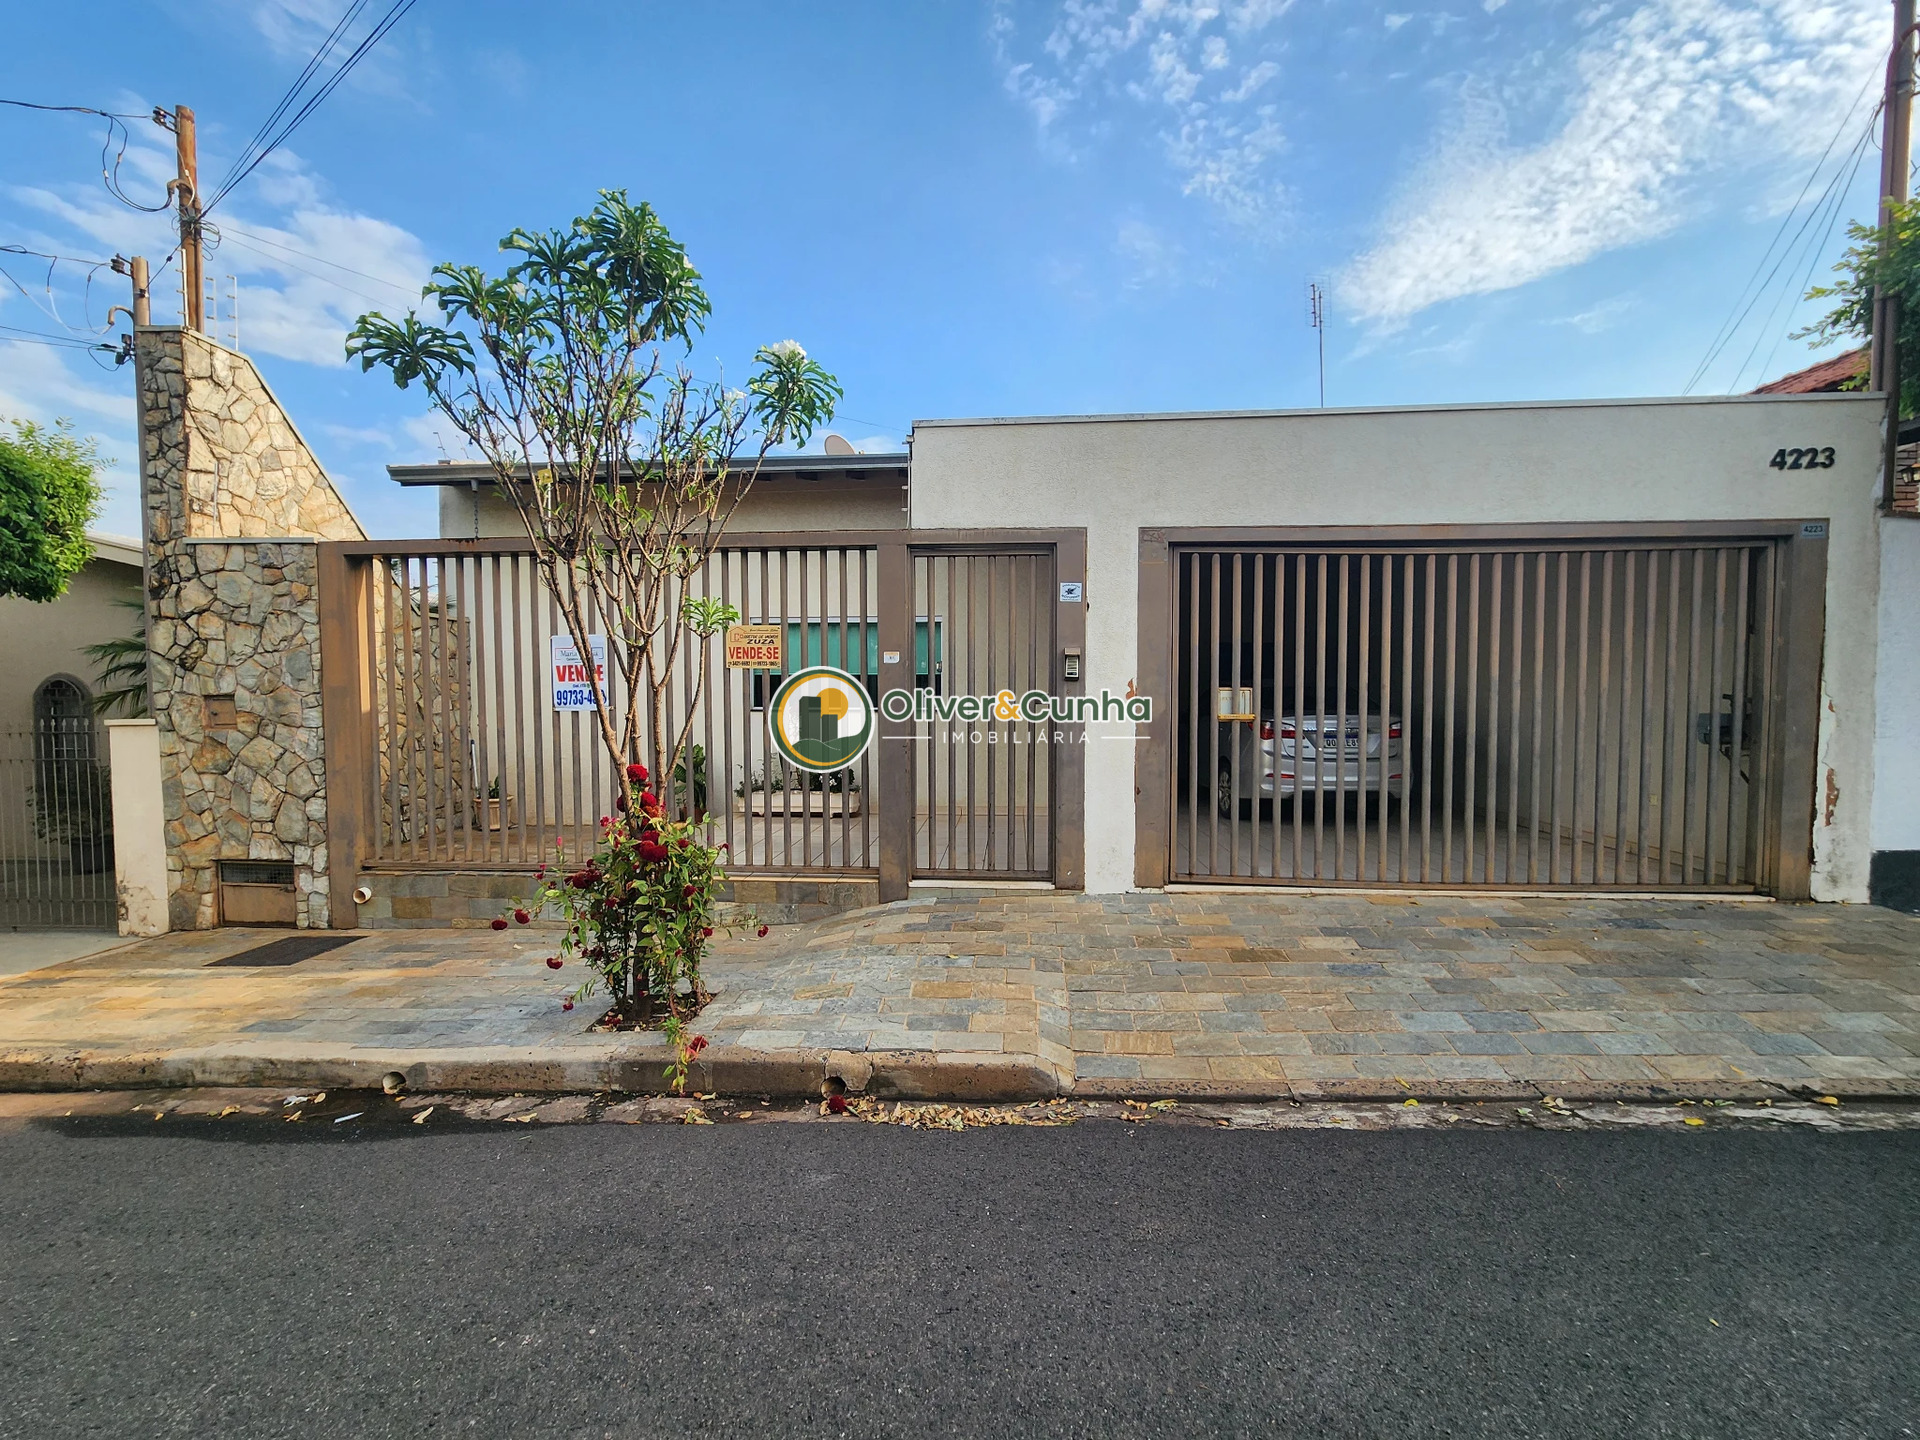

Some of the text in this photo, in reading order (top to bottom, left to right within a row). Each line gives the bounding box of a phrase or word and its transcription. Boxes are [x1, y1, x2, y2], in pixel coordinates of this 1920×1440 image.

[1769, 447, 1835, 470] 4223
[1803, 525, 1823, 533] 4223
[728, 646, 779, 660] VENDE-SE
